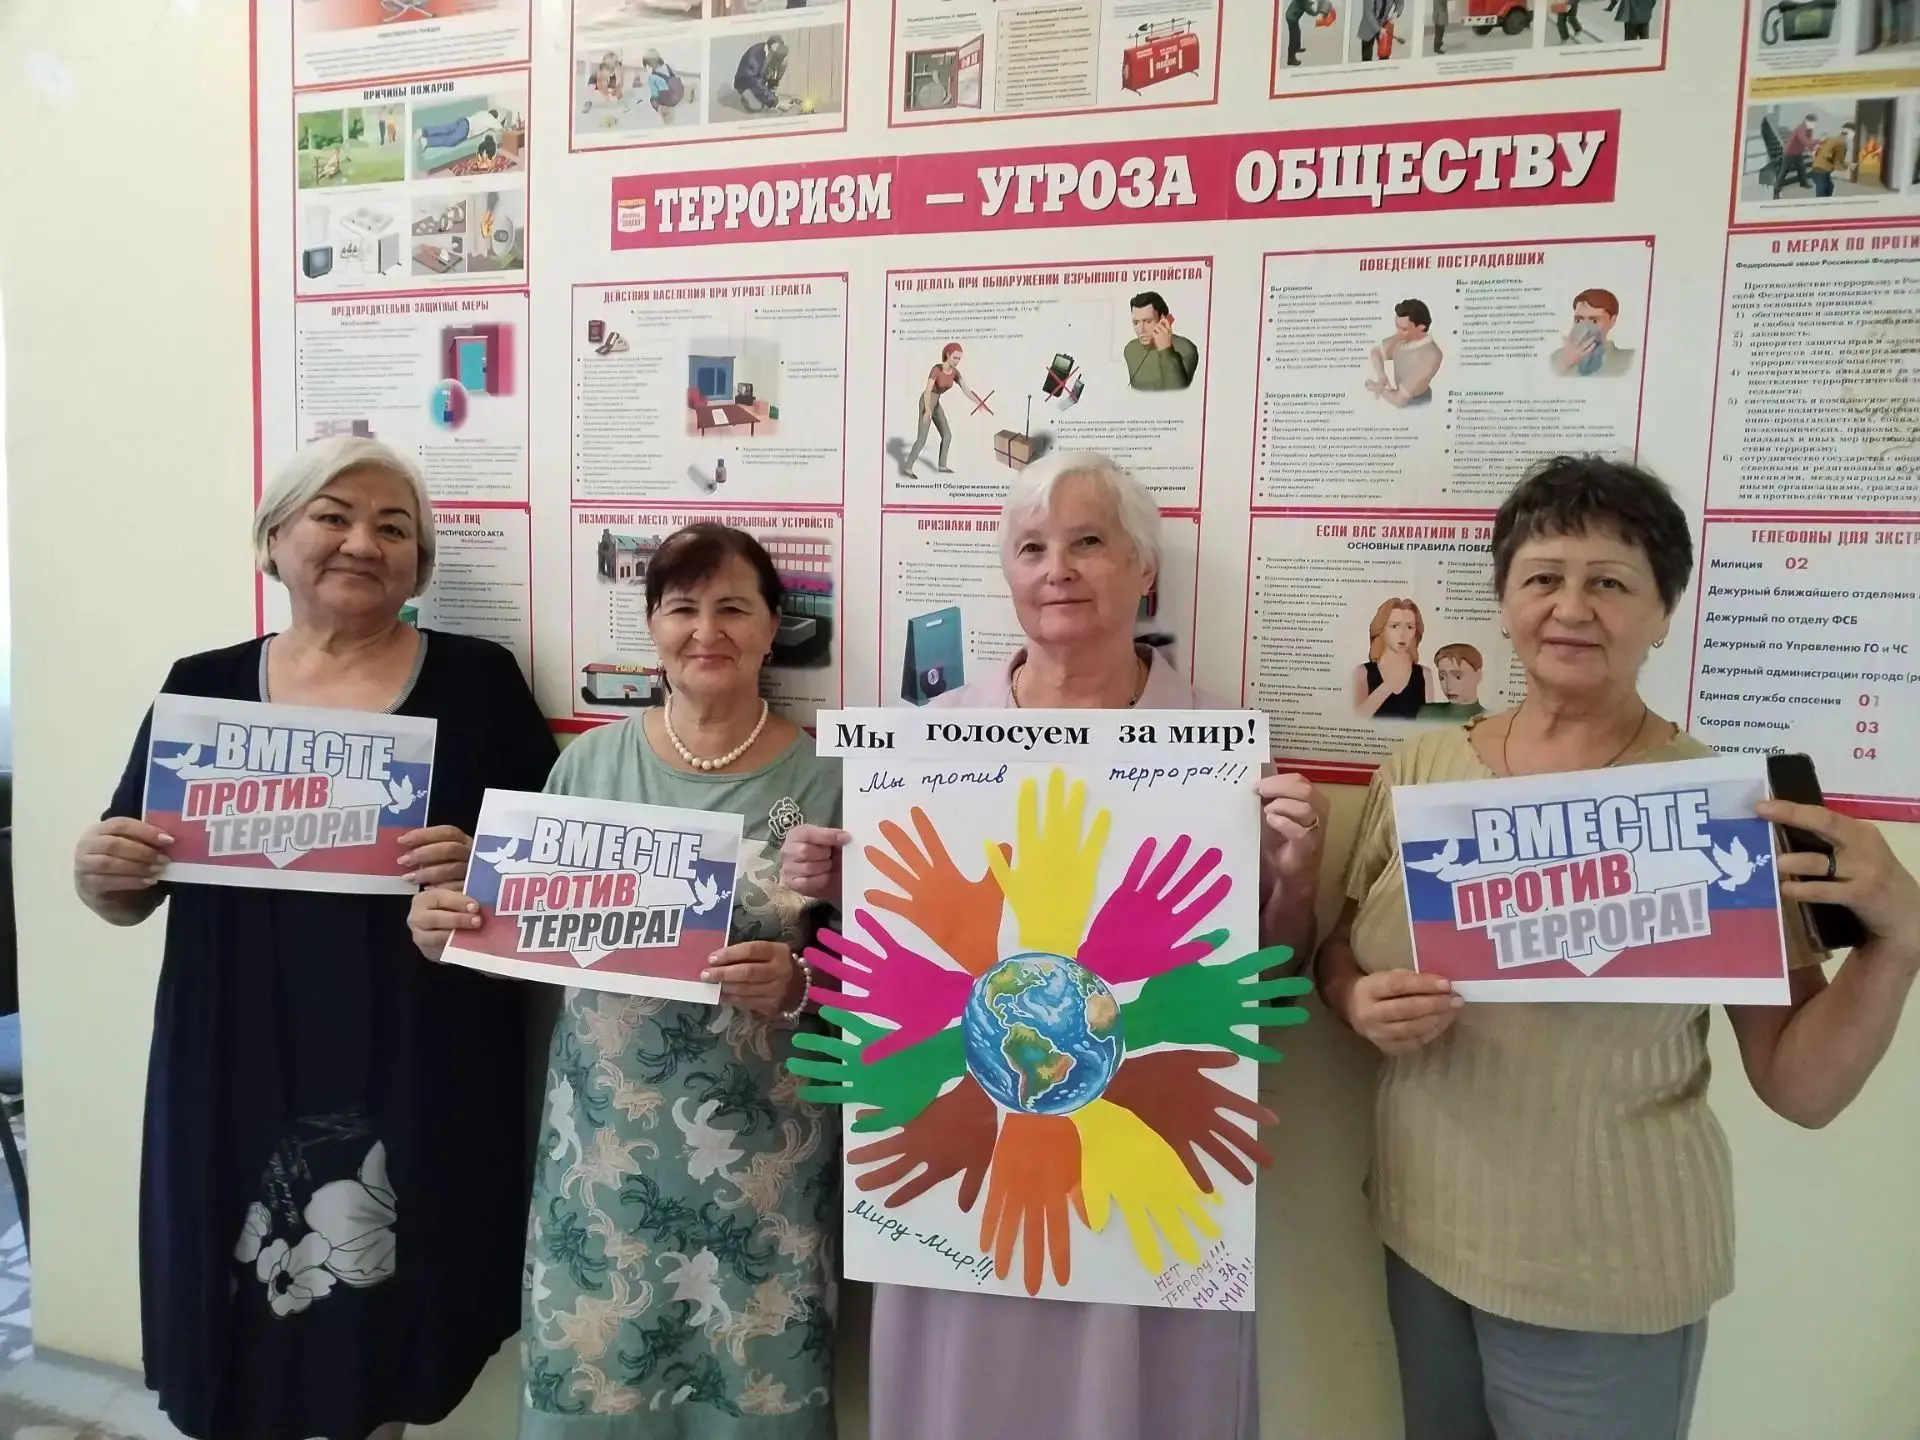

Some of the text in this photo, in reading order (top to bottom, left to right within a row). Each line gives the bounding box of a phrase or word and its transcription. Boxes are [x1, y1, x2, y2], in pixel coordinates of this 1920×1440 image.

[364, 81, 454, 100] ПРИЧИНЫ ПОЖАРОВ
[655, 172, 892, 234] ТЕРРОРИЗМ
[977, 154, 1197, 217] УГРОЗА
[1235, 130, 1606, 209] ОБЩЕСТВУ
[1772, 240, 1780, 254] О
[1787, 237, 1839, 253] МЕРАХ
[1846, 236, 1864, 250] ПО
[1360, 252, 1544, 272] ПОВЕДЕНИЕ ПОСТРАДАВШИХ
[894, 266, 1202, 292] ЧТО ДЕЛАТЬ ПРИ ОБНАРУЖЕНИИ ВЗРЫВНОГО УСТРОЙСТВА
[604, 284, 812, 304] ДЕЙСТВИЯ НАСЕЛЕНИЯ ПРИ УГРОЗЕ ТЕРАКТА
[462, 300, 489, 311] МЕРЫ
[433, 513, 460, 524] СТНЫХ
[578, 512, 634, 524] ВОЗМОЖНЫЕ
[638, 514, 669, 525] МЕСТА
[726, 516, 778, 528] ВЗРЫВНЫХ
[782, 516, 834, 529] УСТРОЙСТВ
[918, 520, 972, 531] ПРИЗНАКИ
[1316, 524, 1494, 540] ЕСЛИ ВАС ЗАХВАТИЛИ В ЗА
[1752, 530, 1832, 544] ТЕЛЕФОНЫ
[1838, 530, 1868, 546] ДЛЯ
[1348, 542, 1404, 550] ОСНОВНЫЕ
[1407, 542, 1456, 552] ПРАВИЛА
[1710, 557, 1809, 571] Милиция 02
[1708, 586, 1916, 600] Дежурный ближайшего отделения
[1706, 612, 1858, 626] Дежурный по отделу ФСБ
[1704, 638, 1766, 650] Дежурный
[1769, 642, 1783, 650] по
[1786, 640, 1861, 653] Управлению
[1864, 644, 1879, 653] ГО
[1892, 644, 1908, 654] ЧС
[1702, 664, 1764, 678] Дежурный
[1766, 669, 1858, 680] администрации
[1861, 672, 1904, 683] города
[1700, 690, 1880, 707] Единая служба спасения 01
[834, 723, 896, 749] Мы
[926, 722, 1091, 751] голосуем
[1118, 724, 1157, 744] за
[1168, 718, 1256, 752] мир!
[1855, 720, 1880, 734] 03
[214, 722, 395, 781] ВМЕСТЕ
[1743, 746, 1786, 756] служба
[1852, 748, 1878, 760] 04
[859, 770, 906, 793] Мы
[921, 764, 1008, 793] против
[186, 776, 330, 818] ПРОТИВ
[210, 808, 377, 854] ТЕРРОРА!
[1472, 788, 1712, 864] ВМЕСТЕ
[530, 816, 702, 880] ВМЕСТЕ
[500, 872, 636, 912] ПРОТИВ
[1456, 852, 1632, 924] ПРОТИВ
[522, 907, 684, 949] ТЕРРОРА!
[1491, 887, 1707, 964] ТЕРРОРА!
[1154, 1263, 1180, 1291] НЕТ
[1192, 1262, 1238, 1308] МЫ ЗА
